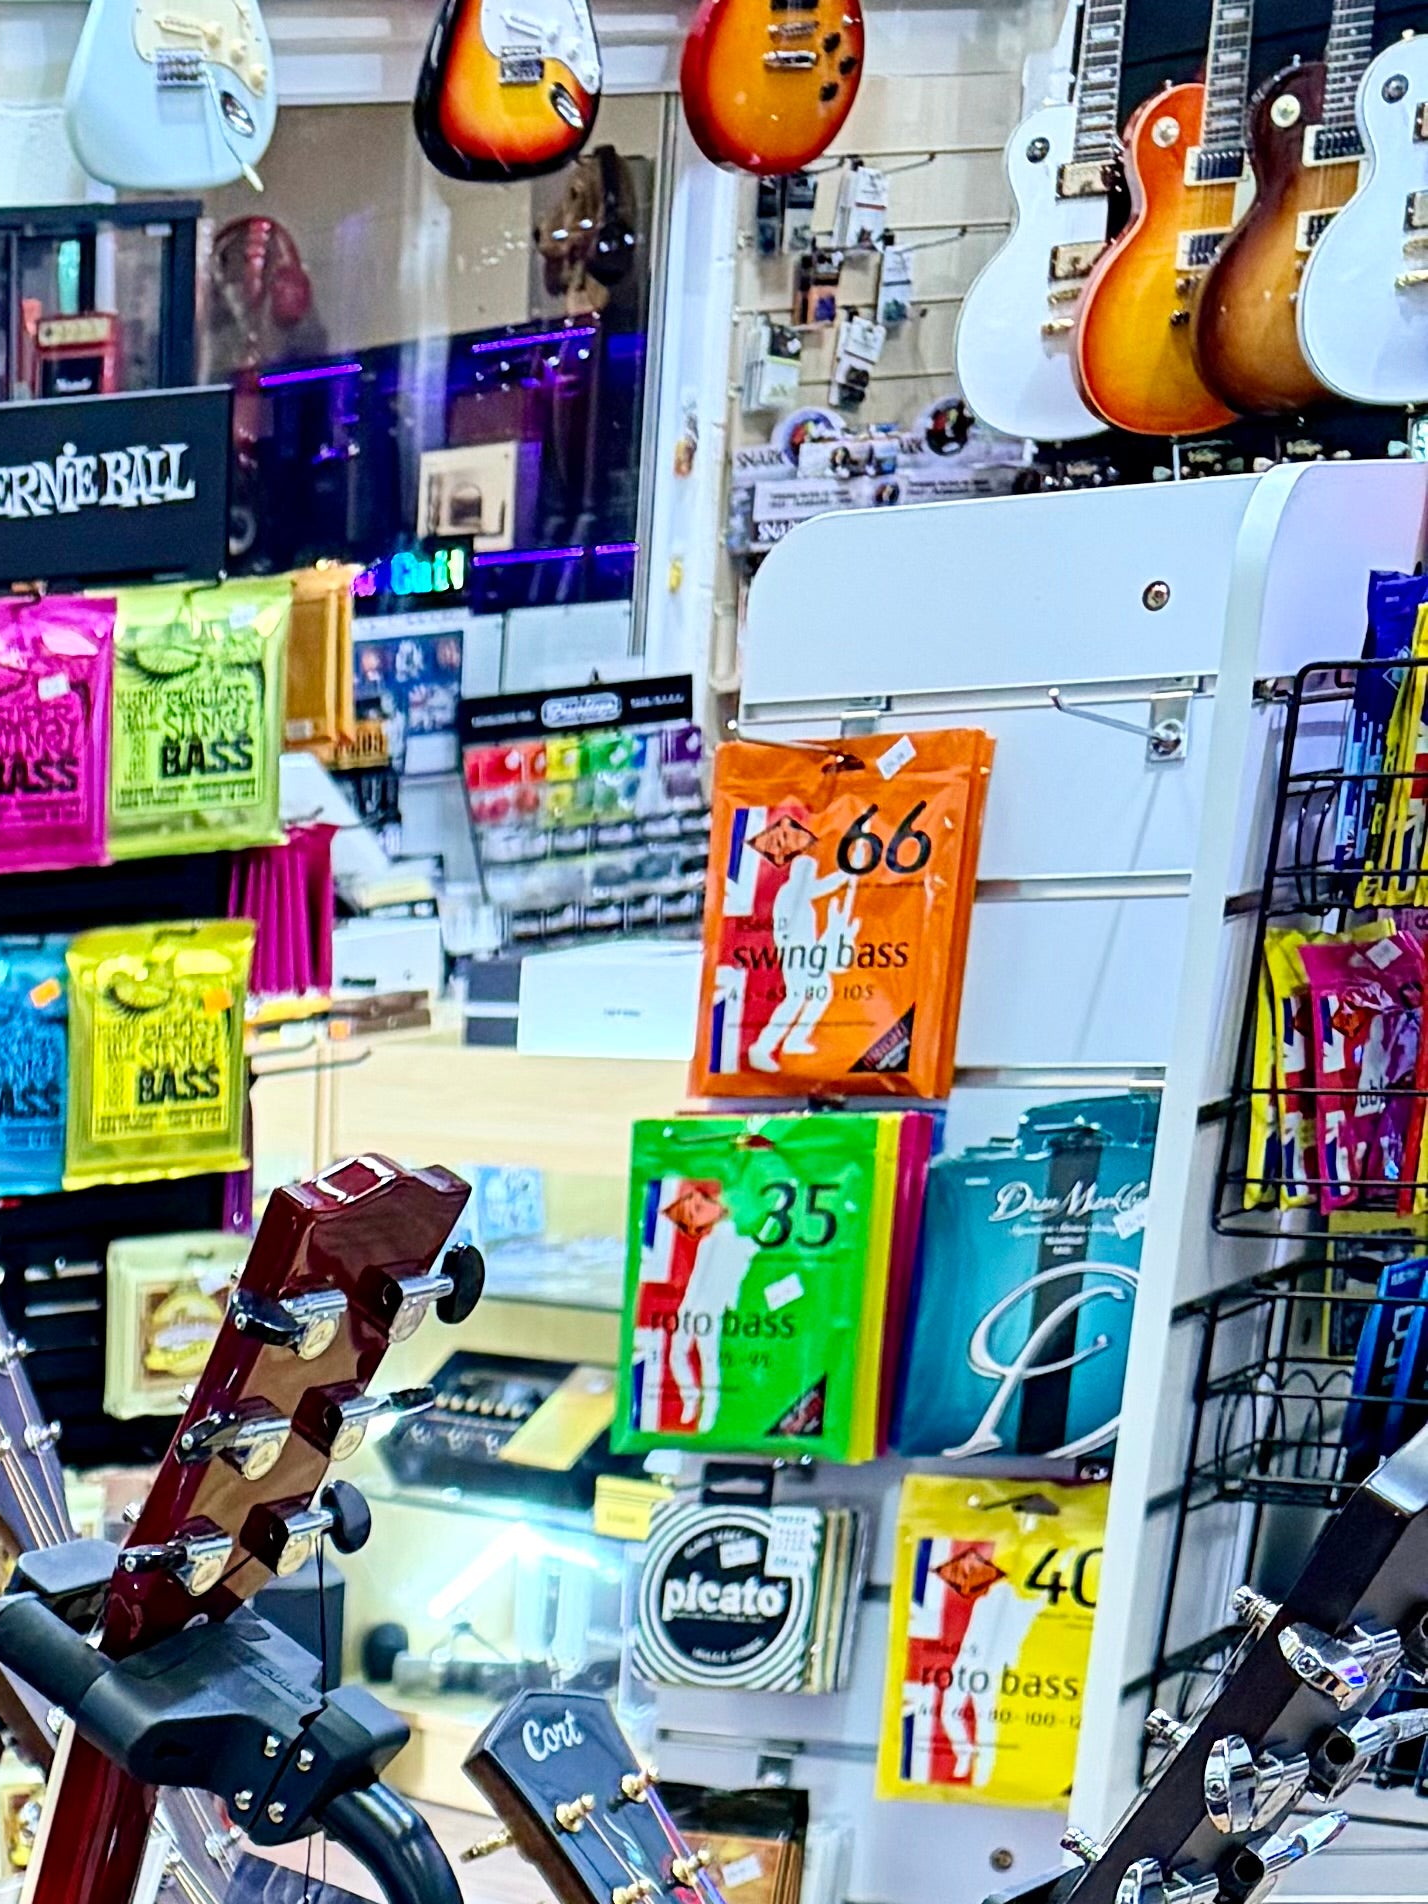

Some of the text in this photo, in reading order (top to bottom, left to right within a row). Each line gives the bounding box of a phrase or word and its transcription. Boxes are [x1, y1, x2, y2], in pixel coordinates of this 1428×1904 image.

[100, 443, 195, 508] BALL
[161, 733, 254, 777] BASS
[837, 800, 932, 876] 66
[733, 934, 910, 977] swing bass
[138, 1064, 220, 1105] BASS
[752, 1182, 840, 1248] 35
[651, 1304, 797, 1338] roto bass
[661, 1571, 786, 1622] picato
[921, 1661, 1079, 1701] roto bass
[522, 1708, 584, 1762] Cort
